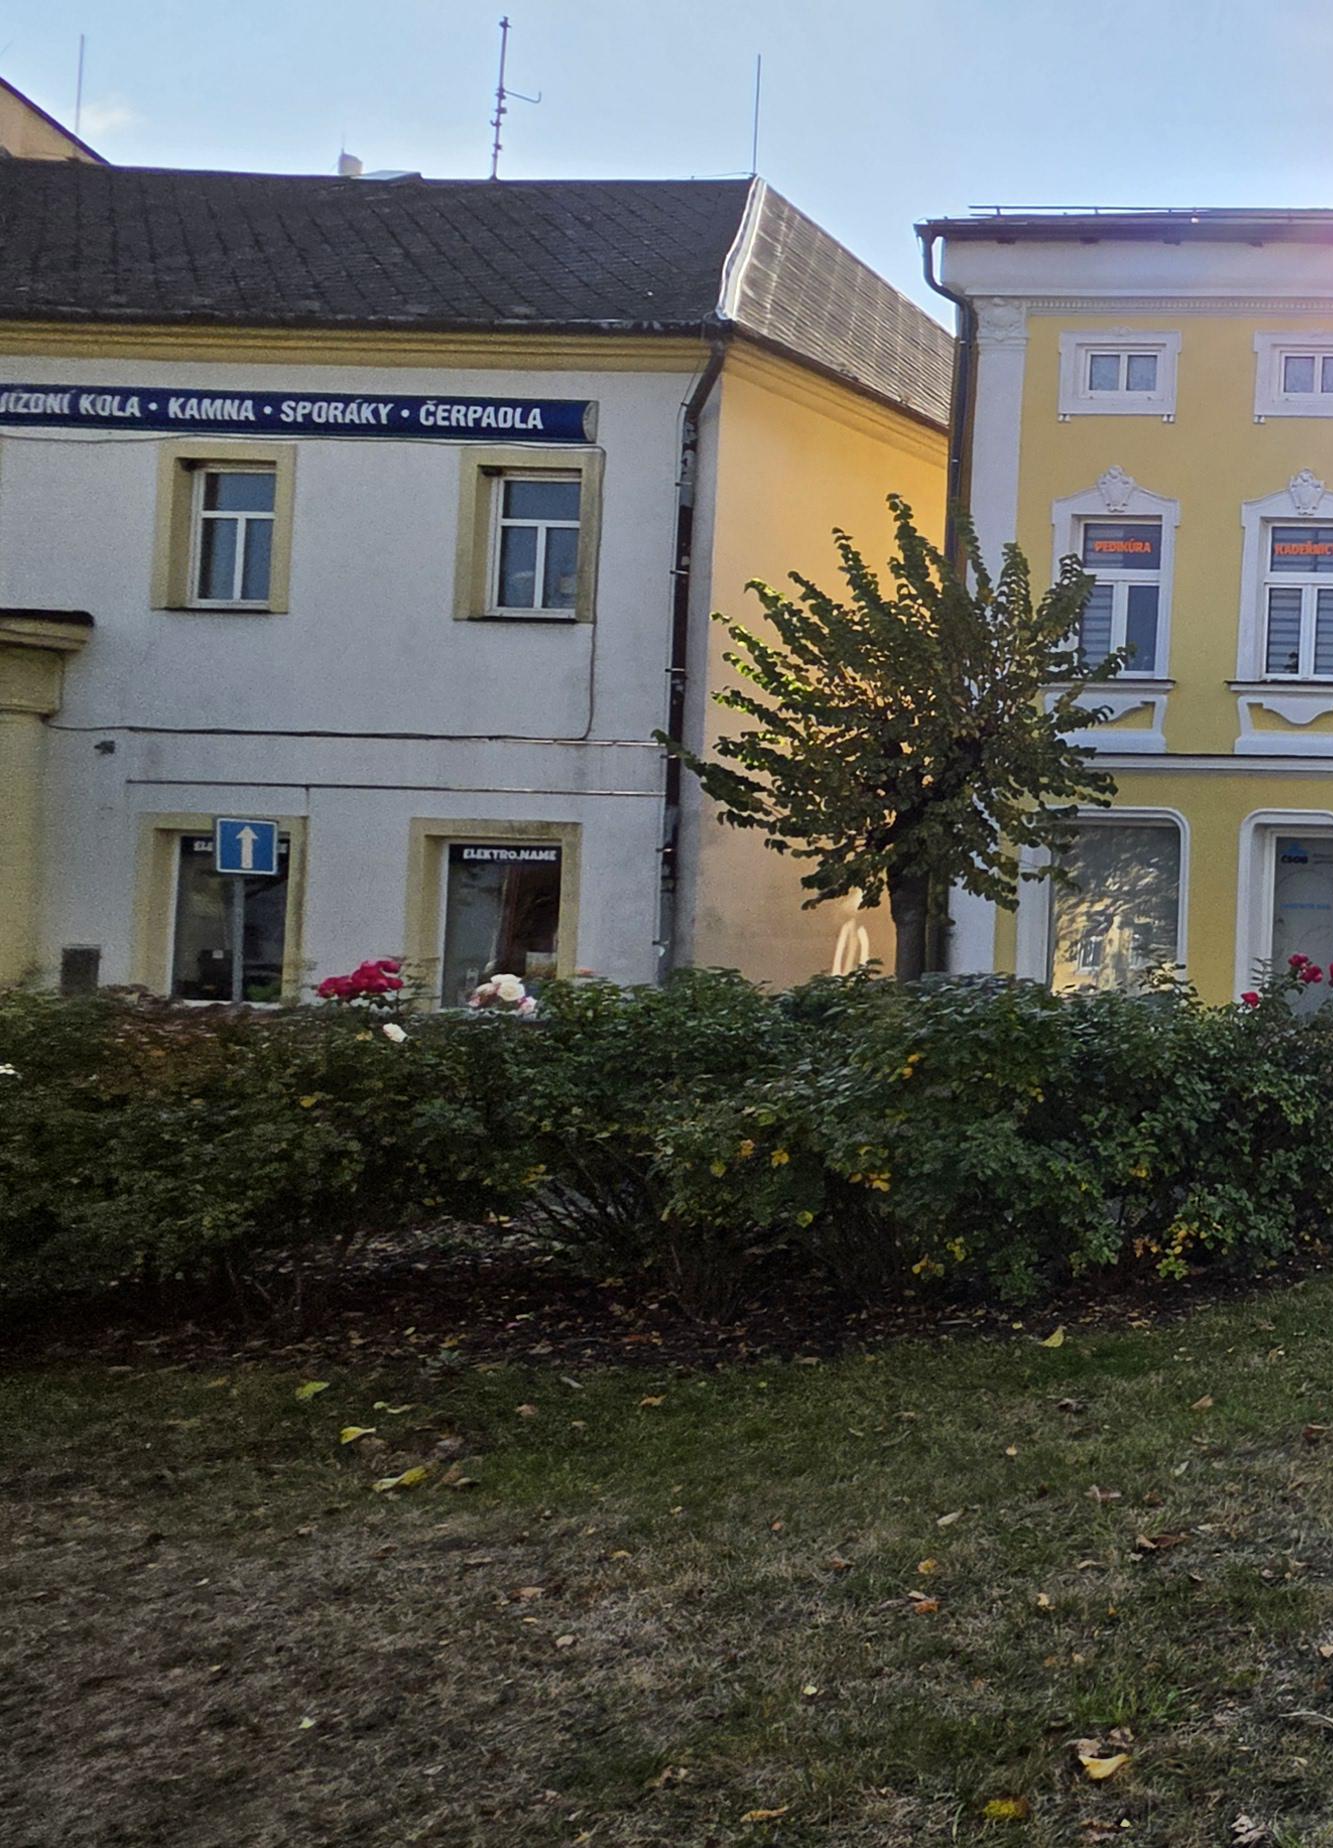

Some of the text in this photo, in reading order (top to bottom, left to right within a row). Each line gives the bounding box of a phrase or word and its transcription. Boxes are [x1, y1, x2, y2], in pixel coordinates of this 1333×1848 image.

[79, 393, 141, 417] KOLA
[168, 396, 255, 421] KAMNA
[280, 399, 394, 425] SPORÁKY
[419, 400, 544, 430] ČERPADLA
[1095, 538, 1152, 553] PEDIKÚRA
[463, 848, 556, 860] ELEKTRO.NAME
